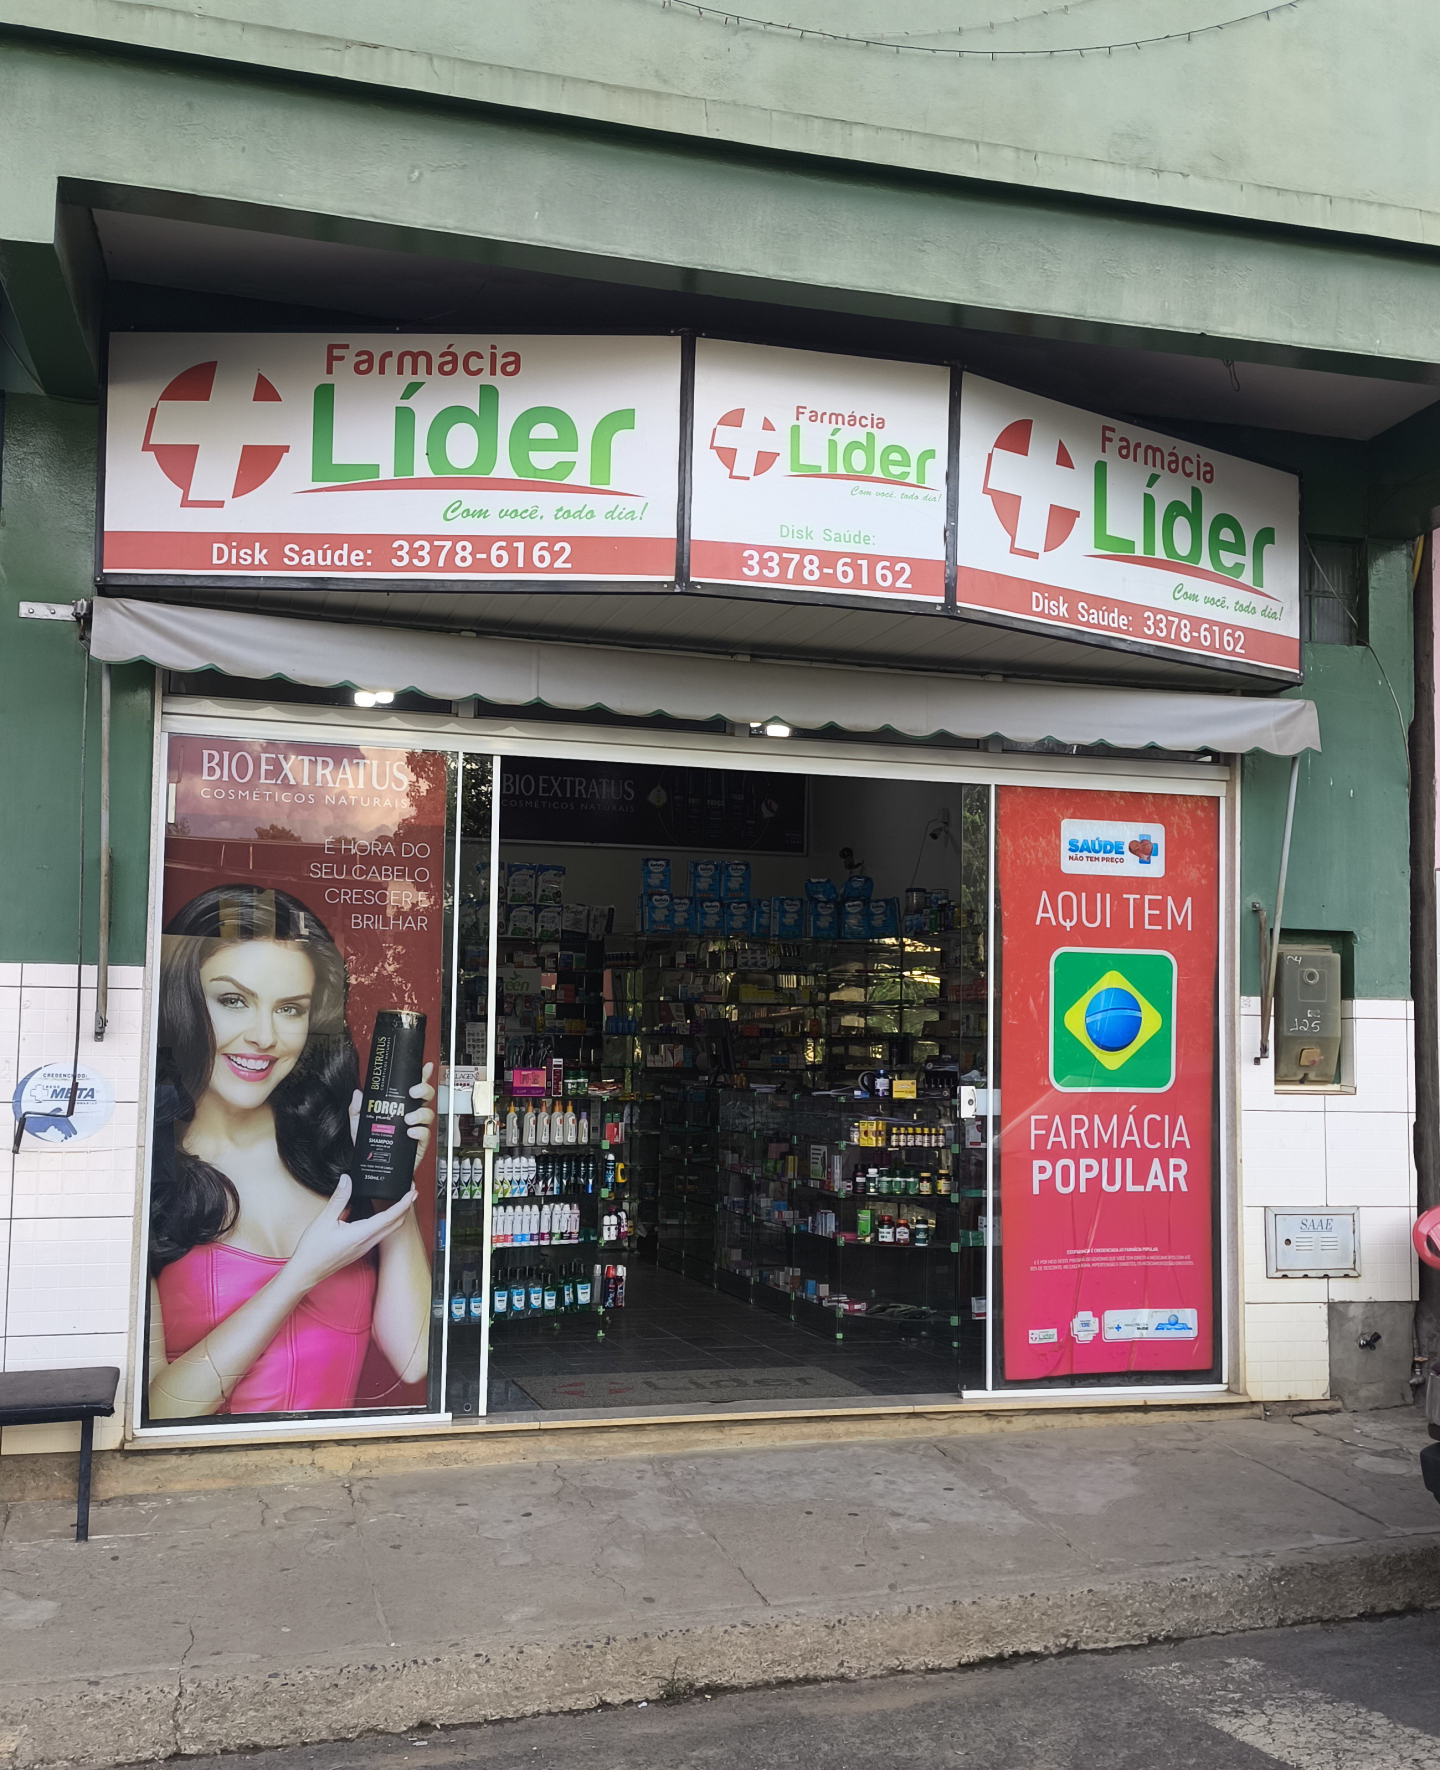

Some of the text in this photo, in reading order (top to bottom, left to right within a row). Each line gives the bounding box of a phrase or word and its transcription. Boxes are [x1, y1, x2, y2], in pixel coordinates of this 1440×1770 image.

[326, 343, 522, 376] Farmácia
[795, 405, 886, 430] Farmácia
[311, 382, 636, 486] Líder
[789, 424, 936, 485] Líder
[1101, 425, 1215, 484] Farmácia
[850, 486, 873, 497] Com
[900, 491, 921, 501] todo
[922, 492, 942, 503] dia!
[442, 499, 490, 522] Com
[554, 502, 596, 521] todo
[604, 501, 649, 523] dia!
[779, 524, 876, 547] Disk Saúde:
[1093, 460, 1276, 588] Líder
[212, 540, 573, 570] Disk Saúde: 3378-6162
[742, 549, 913, 589] 3378-6162
[1171, 583, 1200, 603] Com
[1235, 598, 1259, 616] todo
[1261, 605, 1284, 623] dia!
[1031, 591, 1246, 654] Disk Saúde: 3378-6162
[202, 750, 409, 792] BIO EXTRATUS
[200, 787, 408, 809] COSMÉTICOS NATURAIS
[502, 773, 635, 801] BIO EXTRATUS
[502, 799, 635, 813] COSMÉTICOS NATURAIS
[324, 836, 430, 858] É HORA DO
[1068, 836, 1124, 855] SAÚDE
[1068, 854, 1084, 862] NÃO
[309, 862, 430, 882] SEU CABELO
[324, 888, 429, 907] CRESCER E
[350, 913, 428, 931] BRILHAR
[1035, 890, 1192, 931] AQUI TEM
[503, 981, 530, 992] een
[371, 1036, 387, 1090] BIO EXTRATUS
[50, 1087, 95, 1099] META
[367, 1100, 405, 1117] FORÇA
[1030, 1105, 1191, 1150] FARMÁCIA
[1032, 1157, 1188, 1195] POPULAR
[1300, 1218, 1334, 1230] SAAE
